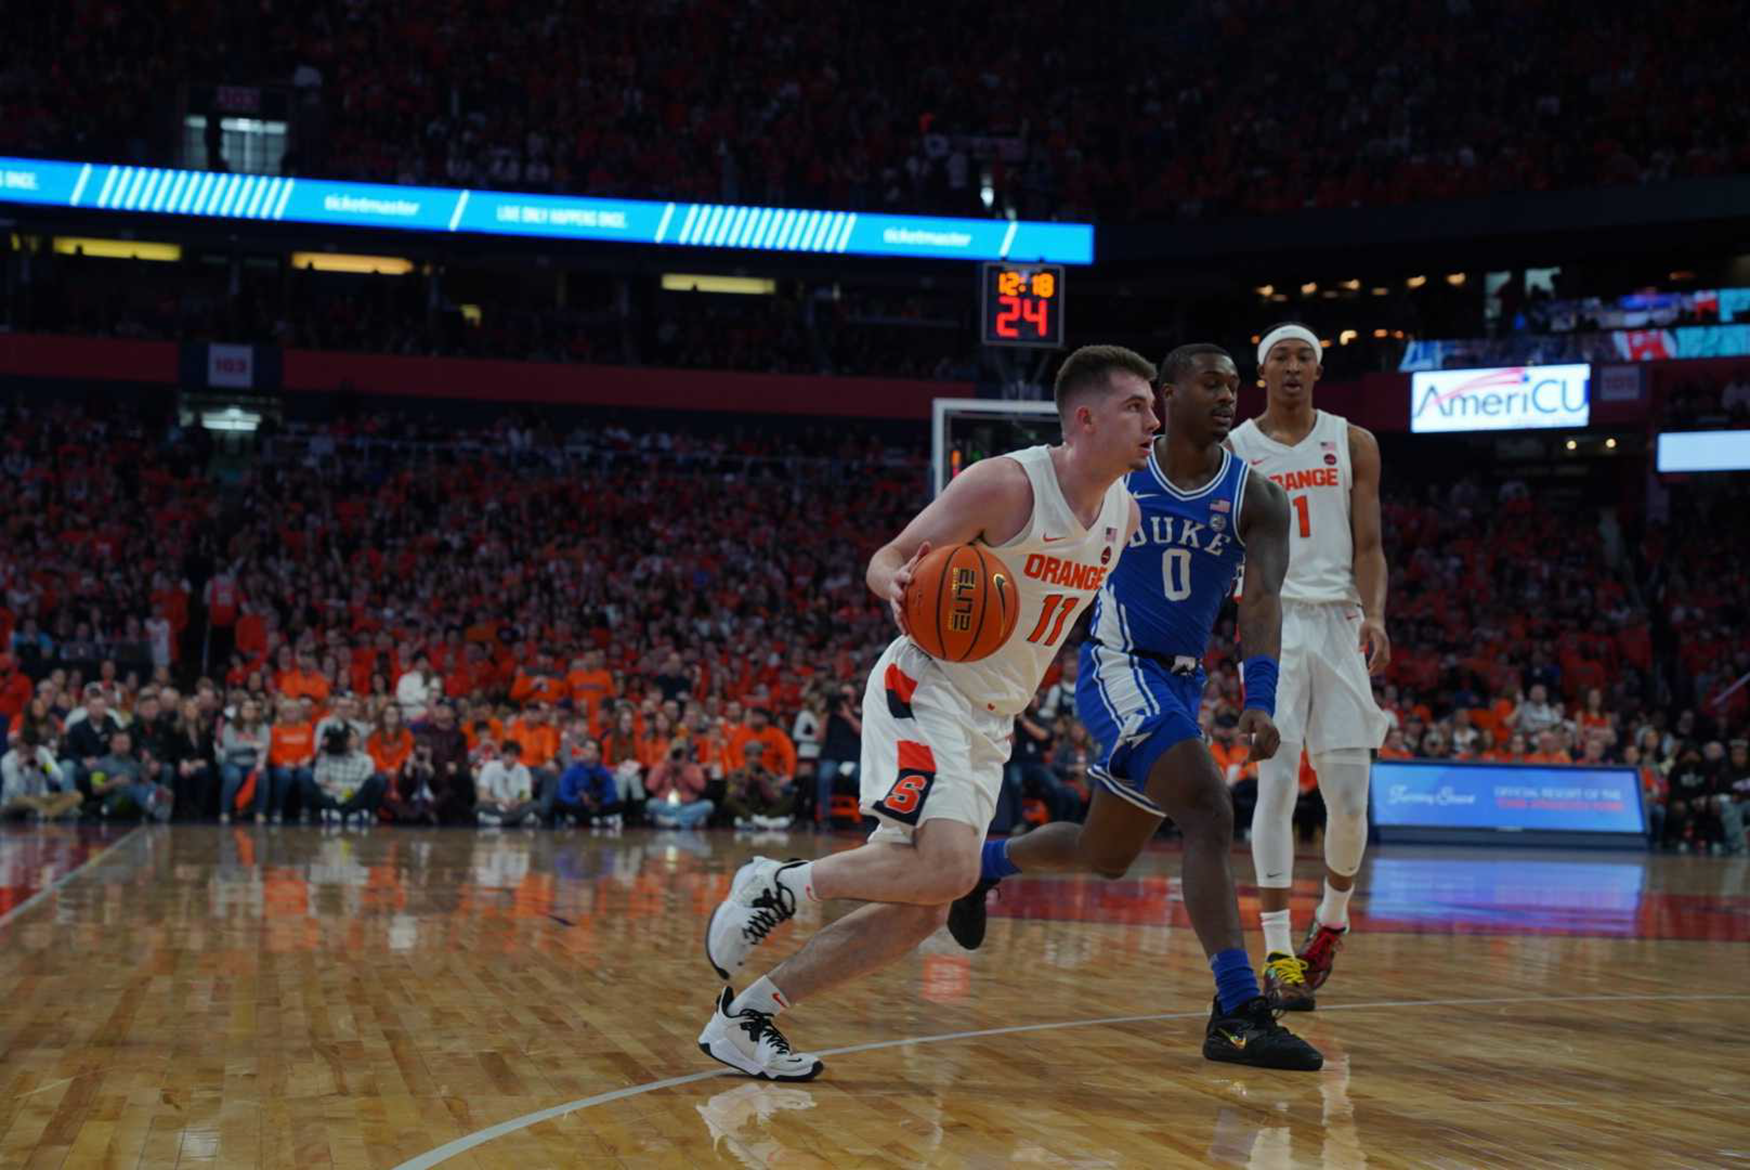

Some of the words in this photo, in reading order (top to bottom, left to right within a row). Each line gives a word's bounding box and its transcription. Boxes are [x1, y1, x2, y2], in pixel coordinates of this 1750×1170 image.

[323, 193, 420, 217] ticketmaster
[883, 227, 972, 247] ticketmaster
[998, 271, 1055, 298] 12:18
[996, 295, 1048, 338] 24
[1416, 378, 1587, 418] AmeriCU
[1269, 468, 1339, 490] ANGE
[1292, 495, 1311, 538] 1
[1024, 554, 1108, 590] ORANGE
[1161, 548, 1192, 602] 0
[953, 567, 975, 632] ELITE
[1027, 593, 1080, 647] 11
[883, 775, 927, 814] S
